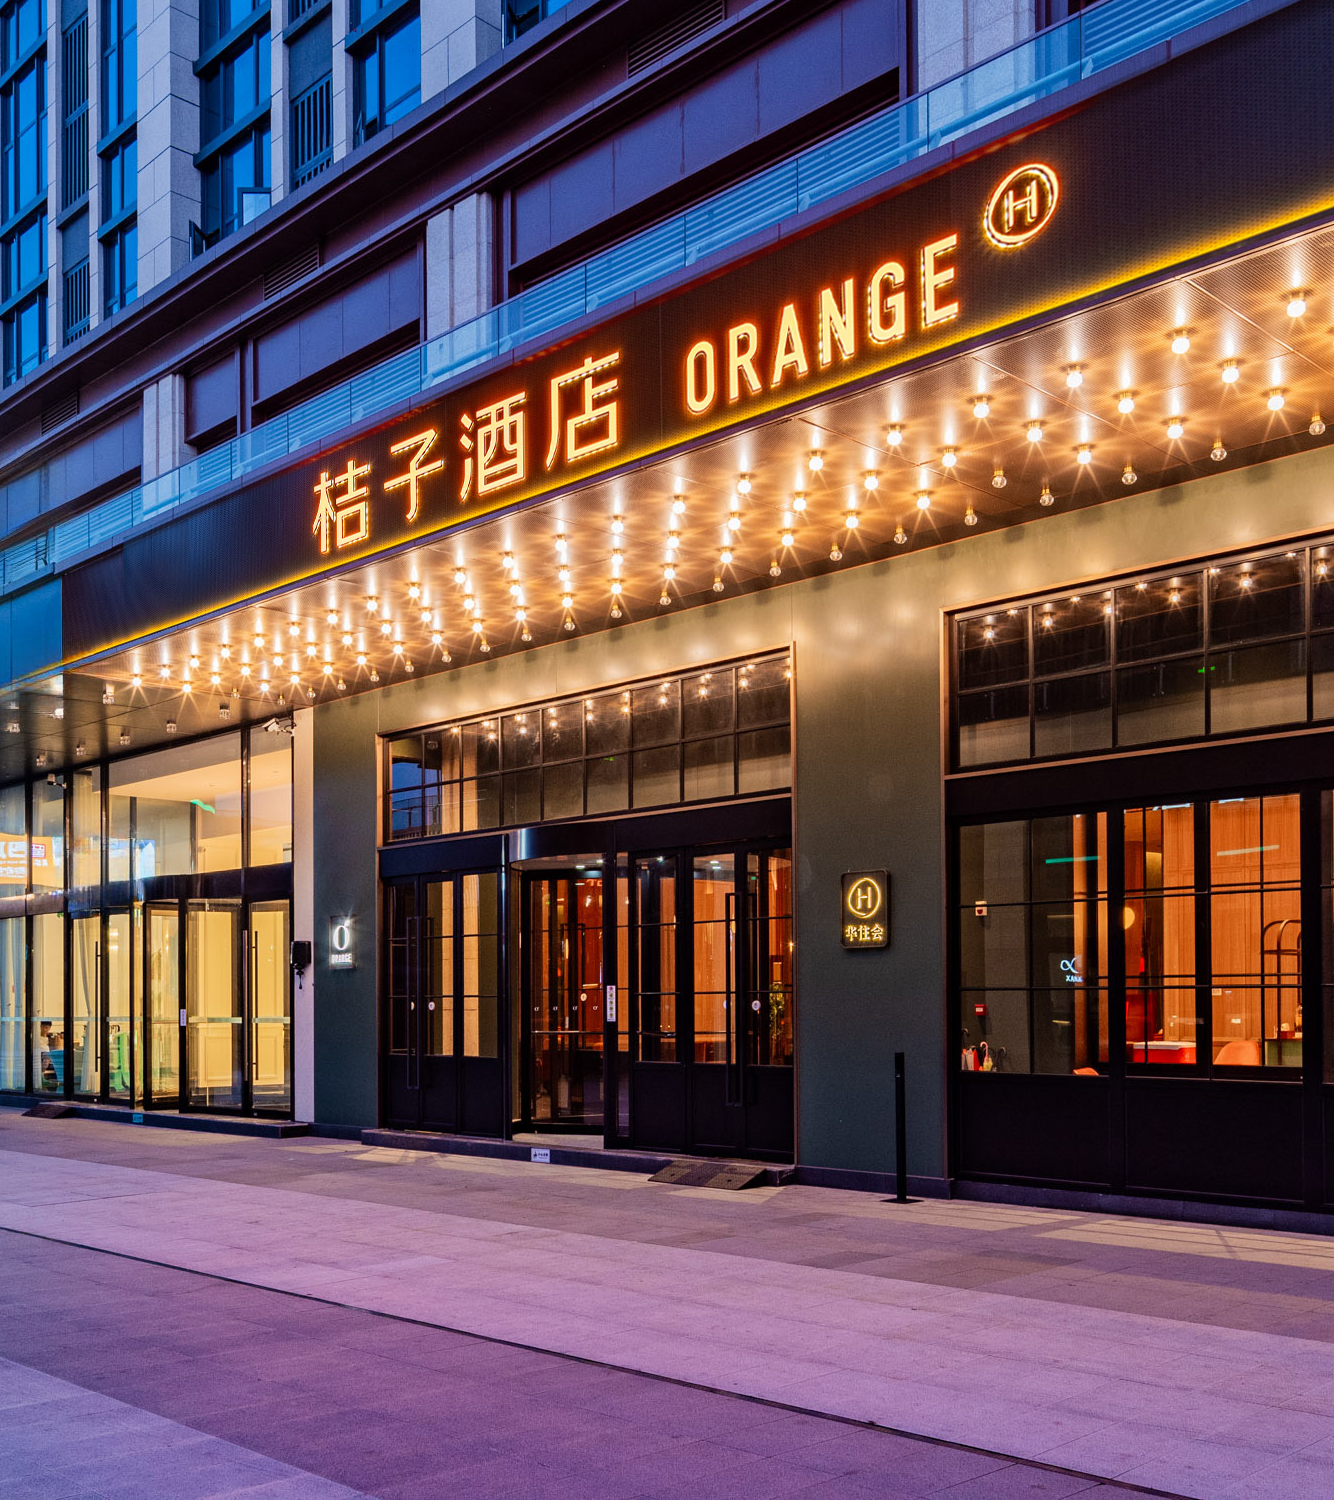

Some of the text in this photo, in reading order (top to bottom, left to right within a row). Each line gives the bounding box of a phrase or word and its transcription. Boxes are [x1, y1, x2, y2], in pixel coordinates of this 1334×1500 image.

[686, 233, 959, 415] ORANGE
[312, 351, 620, 554] 桔子酒店
[845, 923, 884, 941] 华住会
